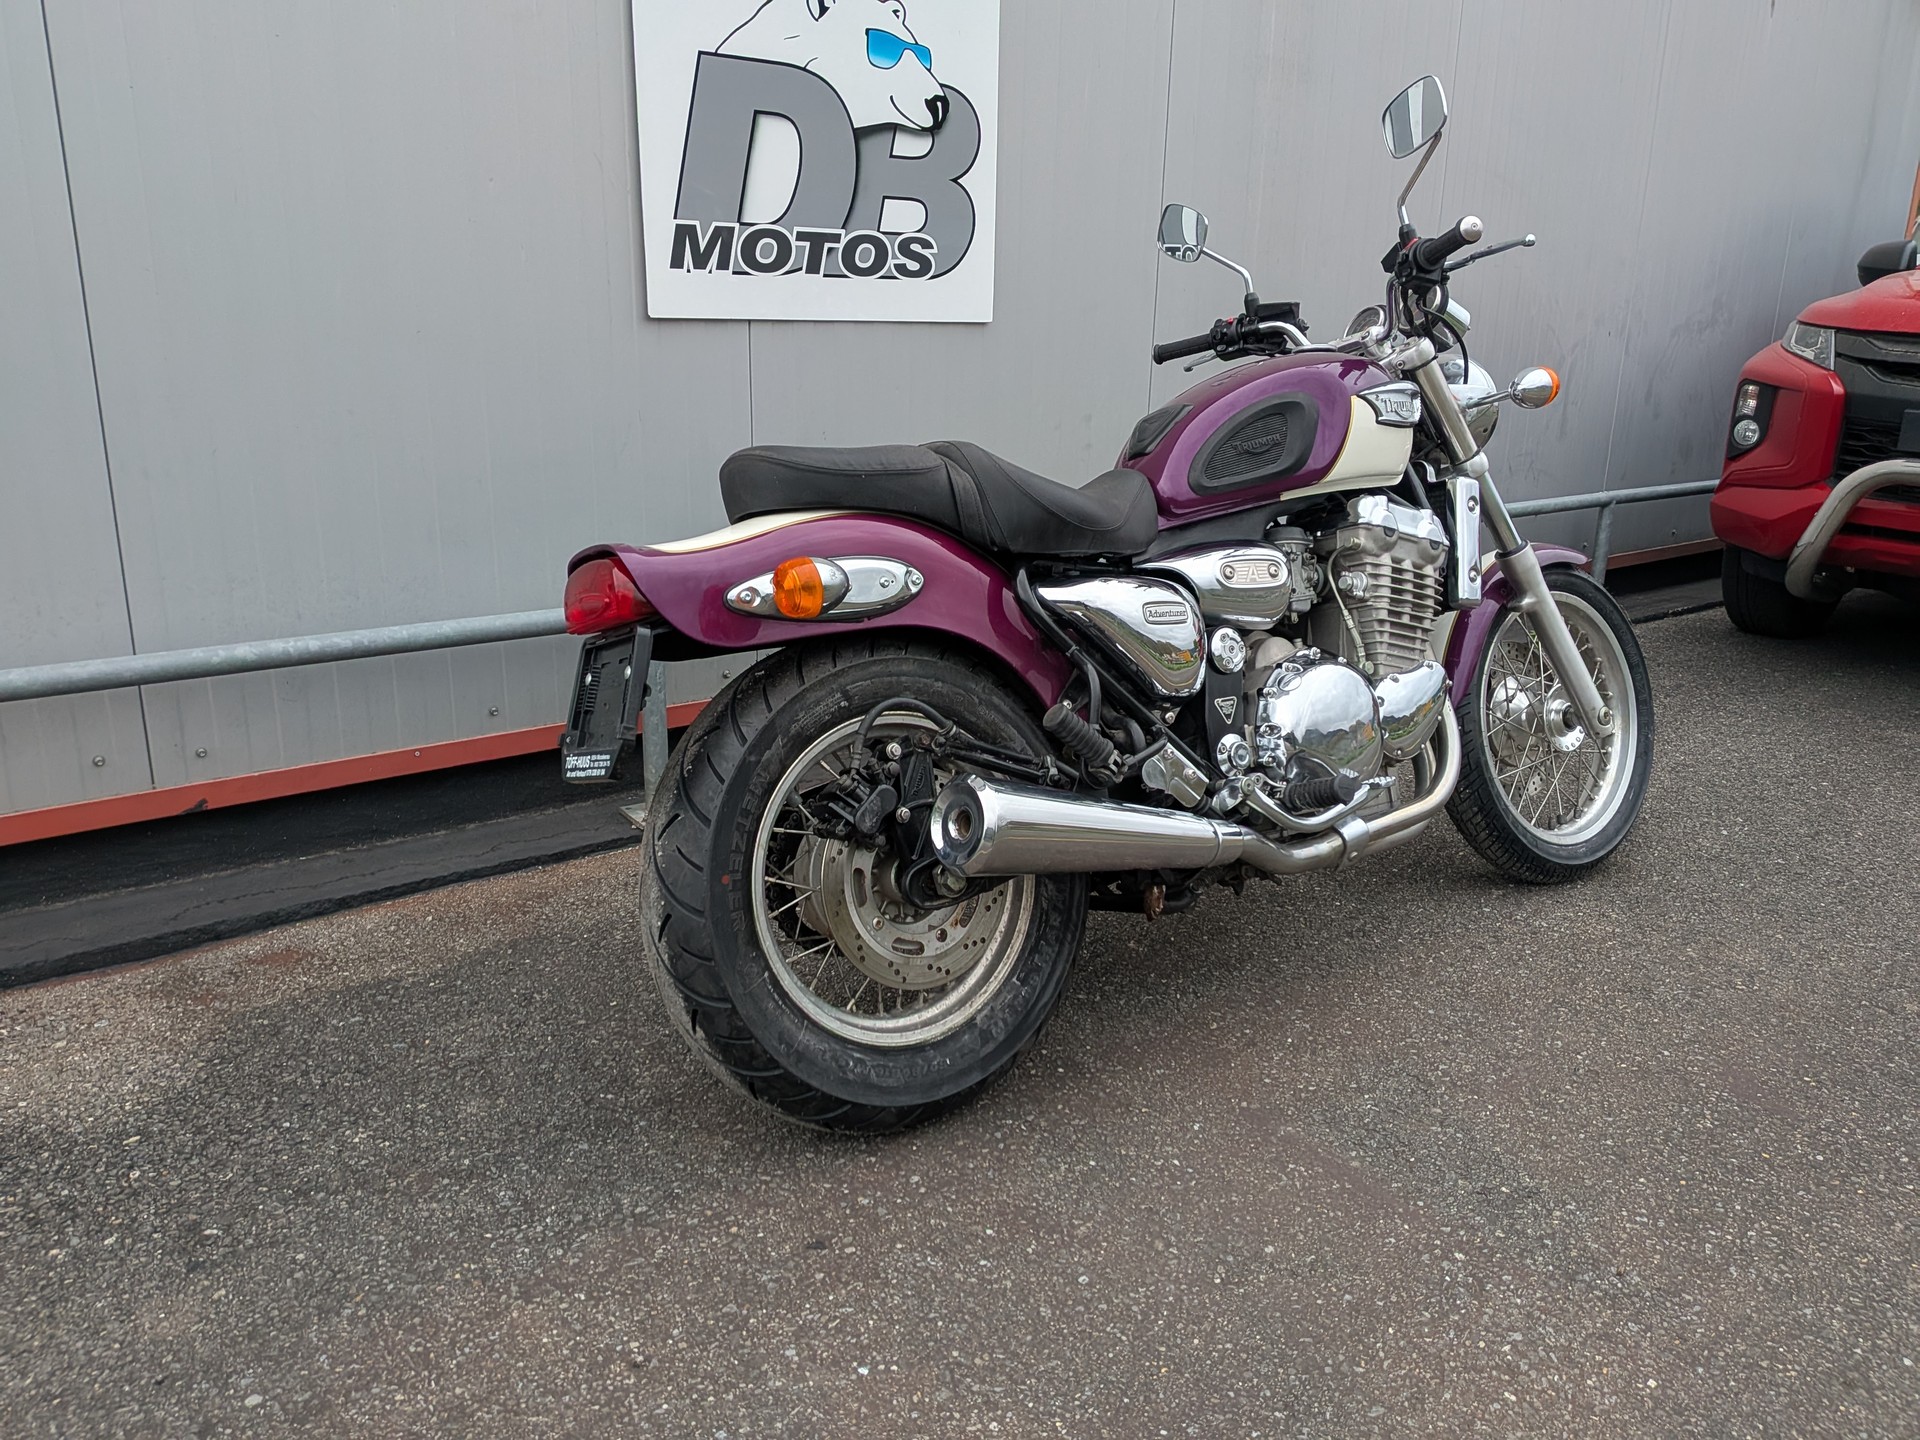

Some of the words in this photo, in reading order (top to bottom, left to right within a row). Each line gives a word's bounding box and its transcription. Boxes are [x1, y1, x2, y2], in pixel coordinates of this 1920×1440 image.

[673, 49, 982, 281] DB
[669, 222, 937, 279] MOTOS
[1231, 433, 1281, 455] TRIUMPH
[1147, 609, 1187, 618] Adventurer
[728, 771, 770, 931] METZELER
